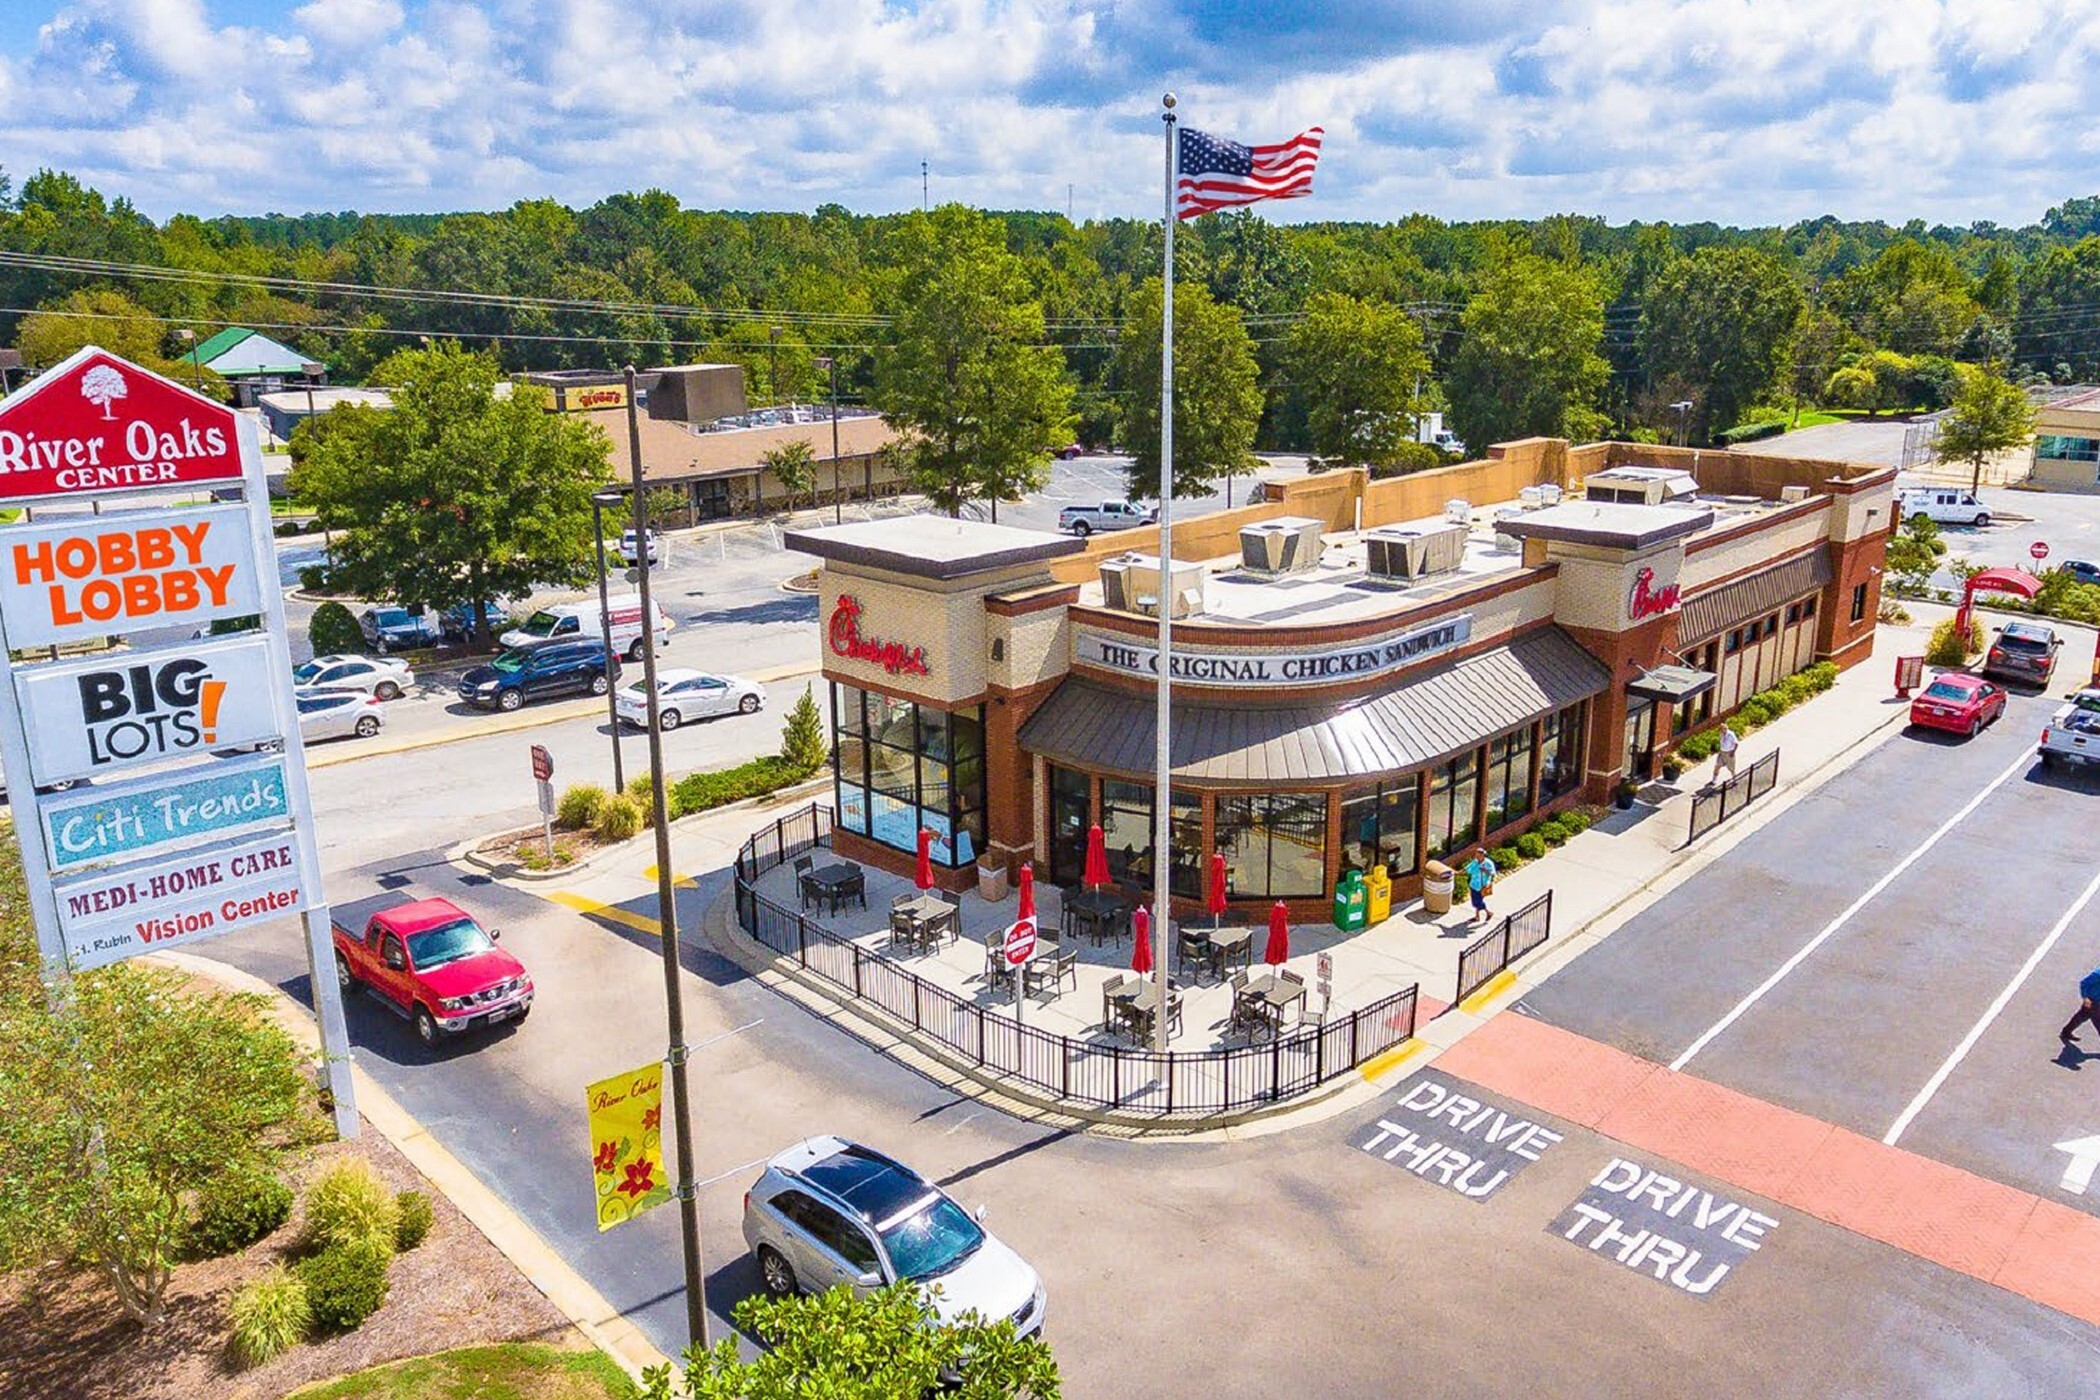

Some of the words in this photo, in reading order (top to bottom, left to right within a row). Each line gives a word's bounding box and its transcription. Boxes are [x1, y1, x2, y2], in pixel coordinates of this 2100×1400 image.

[0, 429, 104, 474] River
[126, 417, 228, 461] Oaks
[55, 461, 178, 489] CENTER
[13, 521, 210, 586] HOBBY
[49, 564, 236, 626] LOBBY
[1100, 643, 1139, 669] THE
[1281, 649, 1381, 679] CHICKEN
[1385, 625, 1456, 663] SANDWICH
[77, 658, 213, 725] BIG
[61, 808, 145, 853] Citi
[155, 779, 279, 833] Trends
[68, 862, 221, 918] MEDI-HOME
[231, 846, 293, 878] CARE
[93, 934, 132, 951] Rubin
[136, 909, 215, 945] Vision
[221, 886, 300, 924] Center
[1397, 1080, 1564, 1161] DRIVE
[1362, 1119, 1509, 1199] THRU
[1591, 1157, 1780, 1251] DRIVE
[1564, 1202, 1731, 1294] THRU
